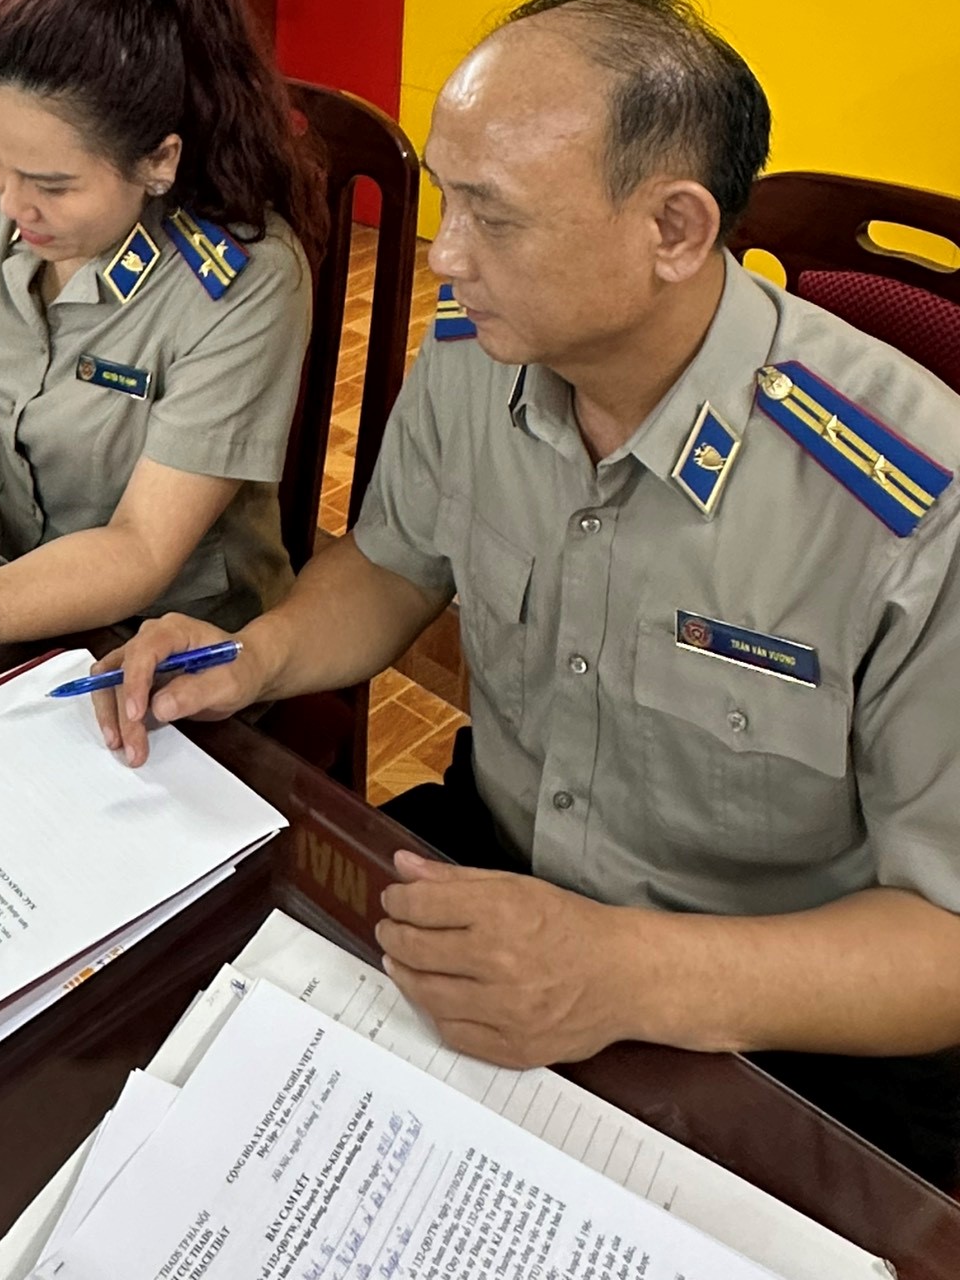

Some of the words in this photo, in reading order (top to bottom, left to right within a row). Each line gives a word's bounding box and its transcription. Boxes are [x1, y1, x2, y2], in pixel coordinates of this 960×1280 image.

[307, 1026, 327, 1049] NAM
[296, 1046, 317, 1069] VIỆT
[279, 1064, 304, 1094] NGHĨA
[268, 1089, 289, 1112] CHỦ
[259, 1108, 278, 1128] HỘI
[250, 1123, 267, 1140] XÃ
[238, 1136, 259, 1159] HÒA
[223, 1155, 249, 1185] CỘNG
[262, 1216, 284, 1242] BẢN
[276, 1192, 298, 1221] CAM
[289, 1168, 312, 1196] KẾT
